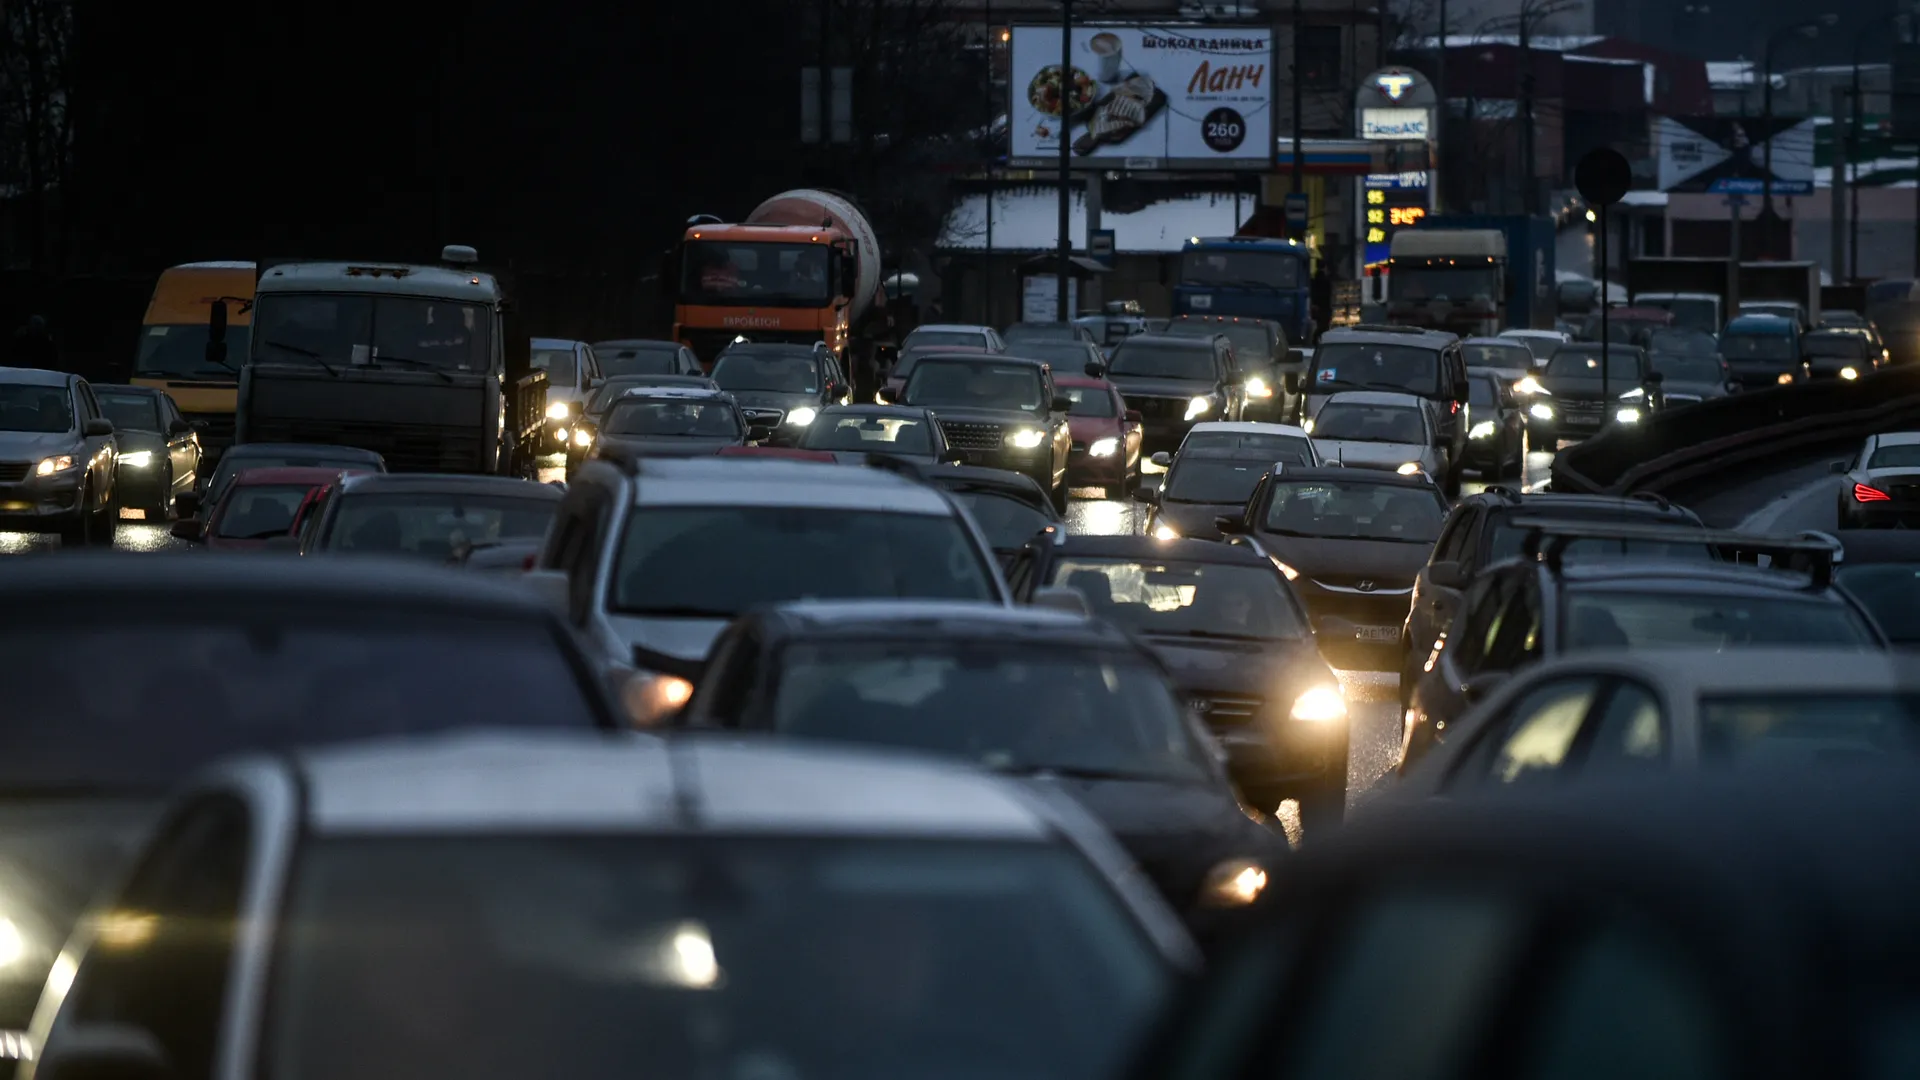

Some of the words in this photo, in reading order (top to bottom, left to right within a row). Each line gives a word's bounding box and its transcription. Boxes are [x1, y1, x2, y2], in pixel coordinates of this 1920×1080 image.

[1142, 36, 1264, 49] ШОКОЛАДНИЦА
[1187, 60, 1265, 94] Ланч
[1208, 122, 1240, 137] 260
[1367, 189, 1385, 205] 95
[1367, 208, 1385, 224] 92
[723, 316, 781, 327] ЕВРОБЕТОН
